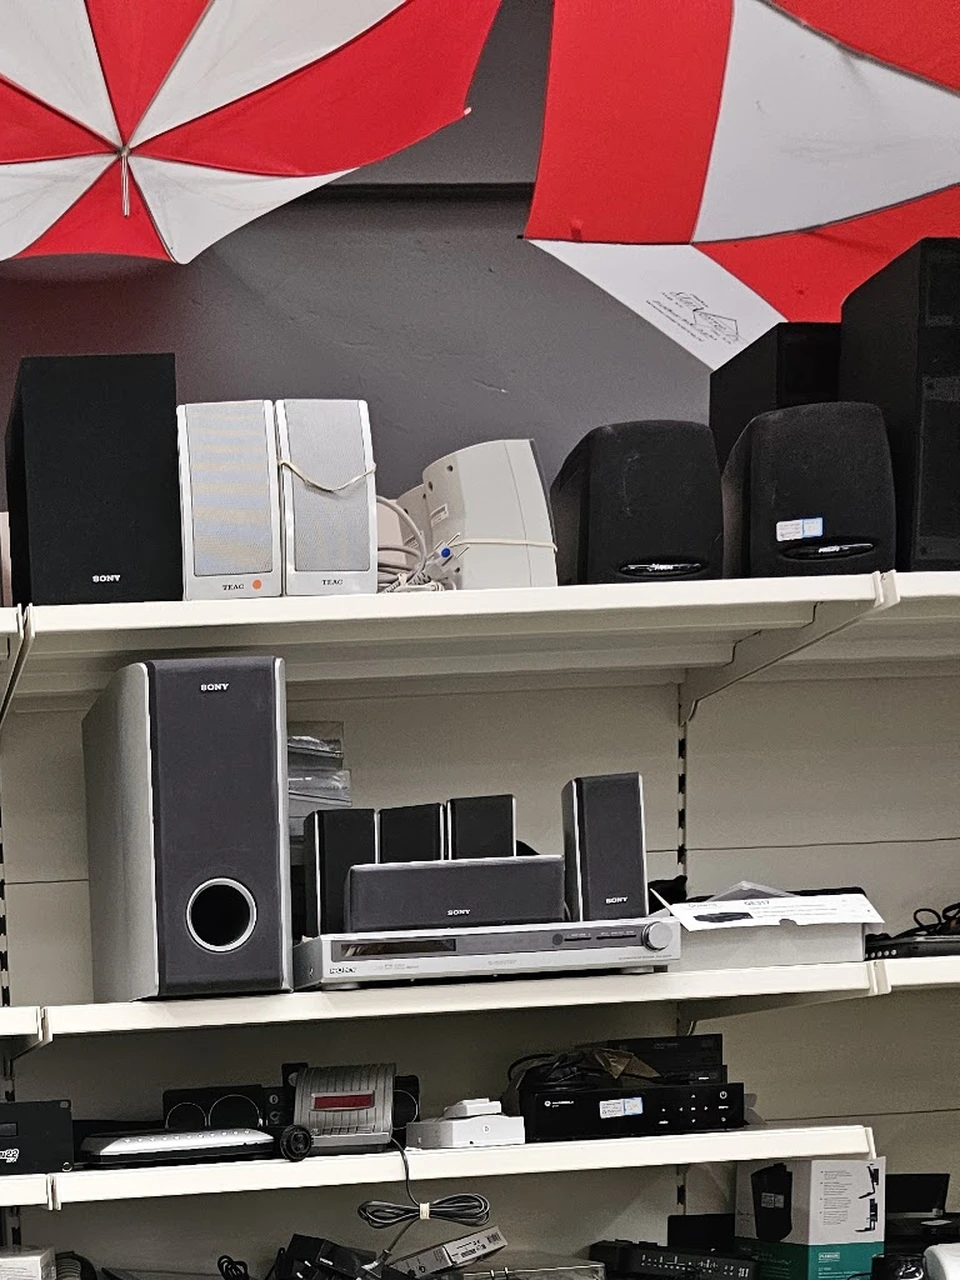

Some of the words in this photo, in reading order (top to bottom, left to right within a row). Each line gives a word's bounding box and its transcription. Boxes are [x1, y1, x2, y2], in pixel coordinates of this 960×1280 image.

[92, 574, 121, 583] SONY
[222, 583, 245, 591] TEAC
[200, 683, 229, 691] SONY
[605, 896, 628, 904] SONY
